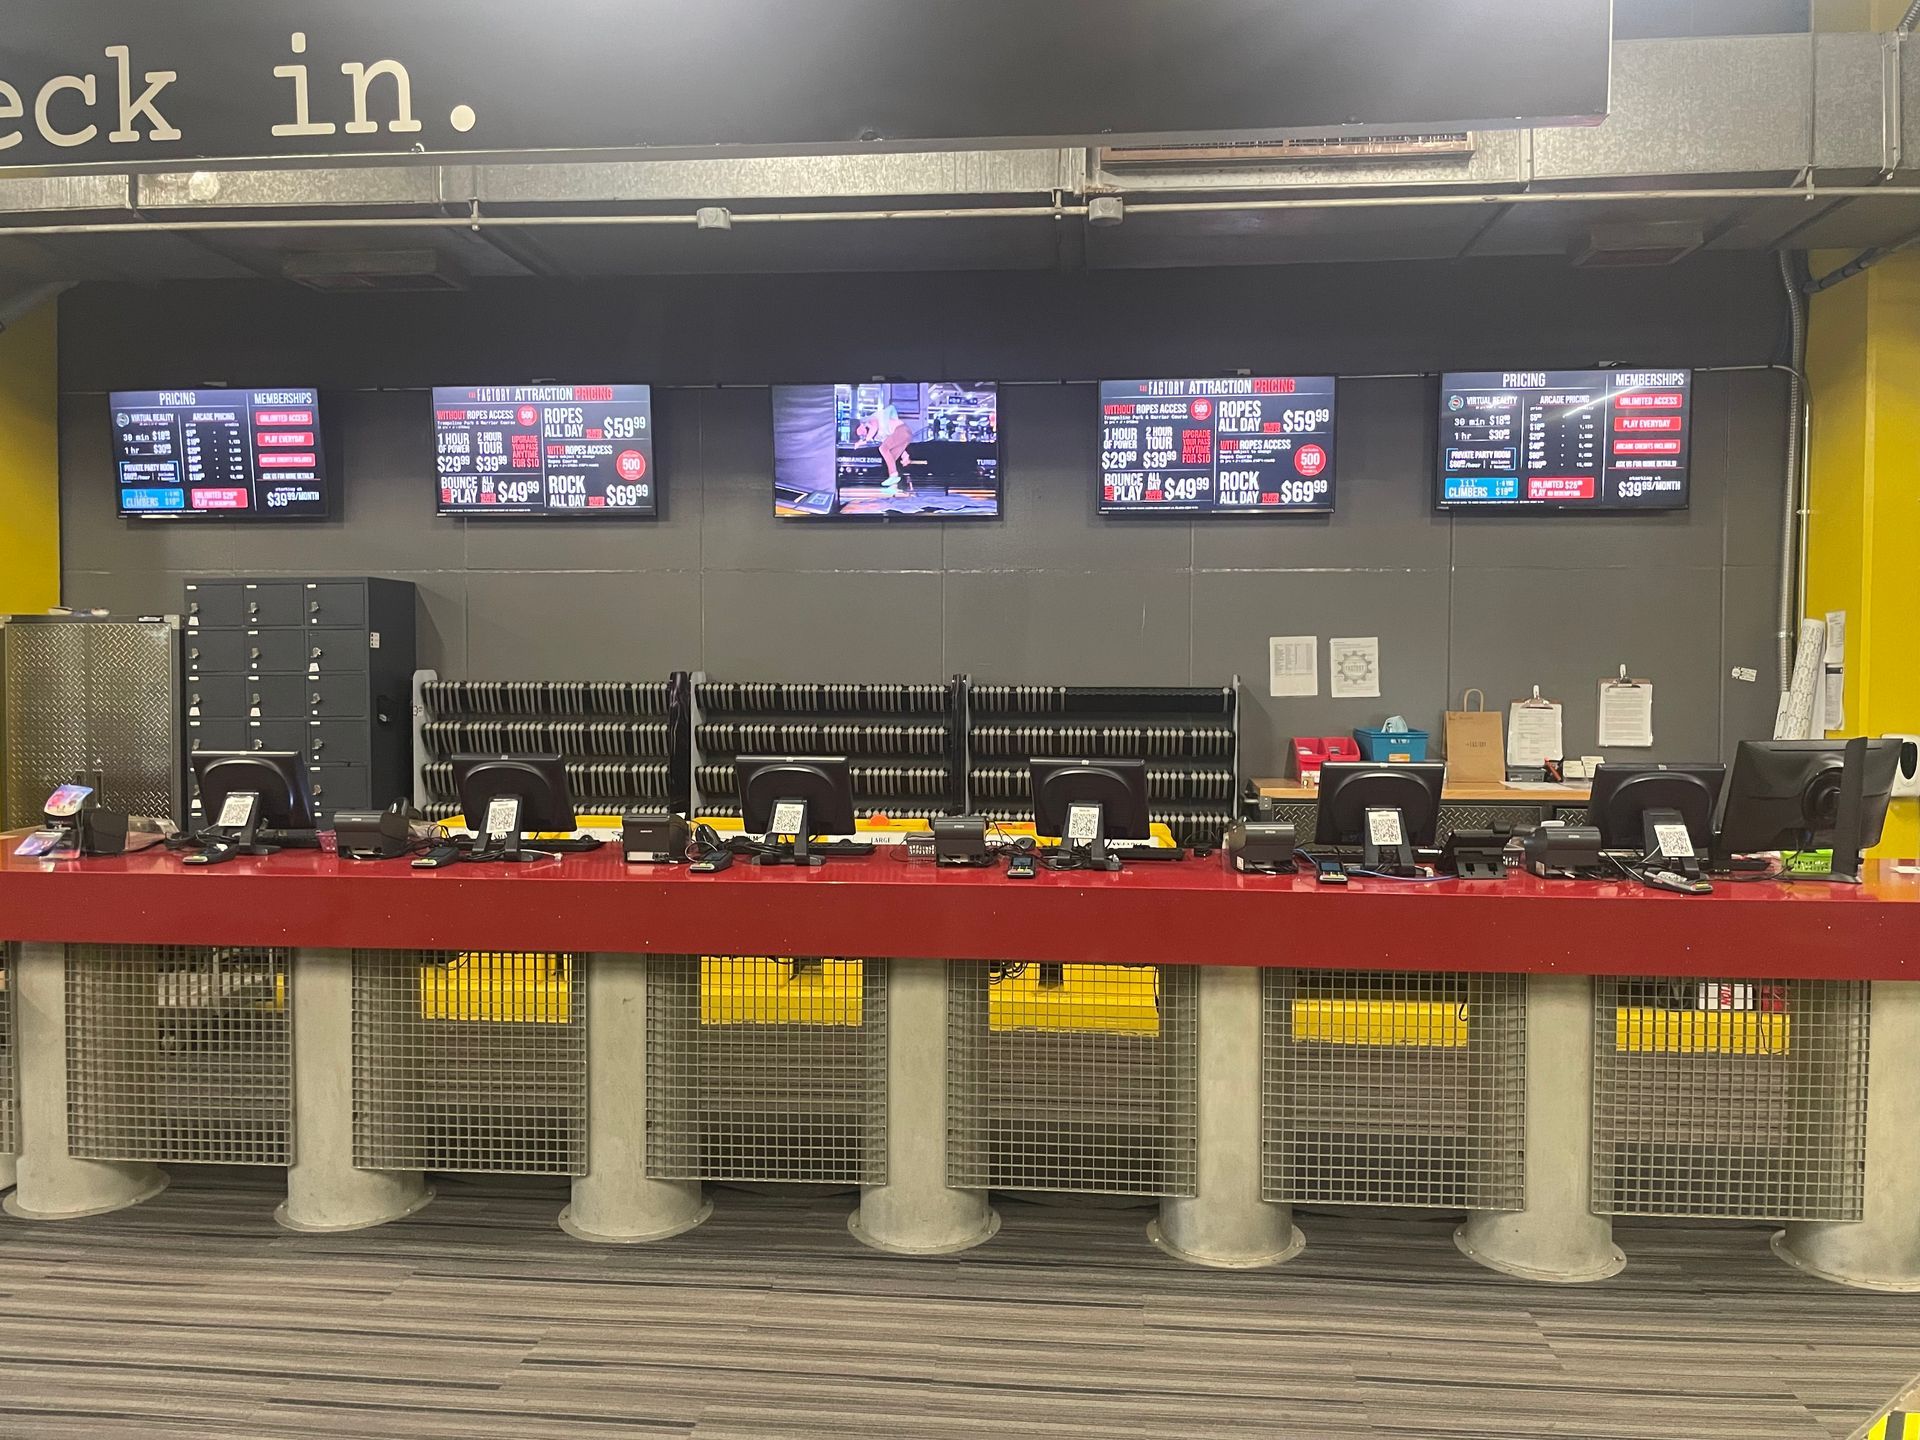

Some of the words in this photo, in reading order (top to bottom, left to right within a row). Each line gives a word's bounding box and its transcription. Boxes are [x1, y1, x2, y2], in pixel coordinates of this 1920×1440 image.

[271, 32, 476, 137] in.
[1503, 373, 1546, 387] PRICING
[1616, 373, 1684, 386] MEMBERSHIPS
[1149, 381, 1184, 395] FACTORY
[1188, 380, 1251, 394] ATTRACTION
[1253, 379, 1296, 393] PRICING
[160, 392, 196, 405] PRICING
[254, 392, 312, 404] MEMBERSHIPS
[477, 388, 510, 401] FACTORY
[515, 388, 572, 401] ATTRACTION
[575, 387, 613, 400] PRICING
[1540, 396, 1564, 404] ARCADE
[1566, 395, 1589, 403] PRICING
[1466, 396, 1490, 405] VIRTUAL
[1493, 396, 1518, 404] REALITY
[1620, 398, 1653, 406] UNLIMITED
[1654, 397, 1677, 405] ACCESS
[1104, 405, 1135, 414] WITHOUT
[1136, 404, 1158, 414] ROPES
[1160, 404, 1186, 414] ACCESS
[1219, 400, 1261, 418] ROPES
[437, 410, 465, 420] WITHOUT
[467, 410, 488, 419] ROPES
[488, 410, 514, 419] ACCESS
[544, 407, 583, 424] ROPES
[1218, 418, 1238, 432] ALL
[1240, 418, 1261, 432] DAY
[1454, 418, 1465, 426] 30
[1623, 420, 1638, 428] PLAY
[1640, 419, 1671, 427] EVERYDAY
[545, 424, 562, 437] ALL
[565, 424, 583, 437] DAY
[1104, 428, 1109, 440] 1
[1112, 428, 1137, 440] HOUR
[1146, 427, 1152, 437] 2
[1153, 427, 1172, 436] HOUR
[1183, 430, 1211, 438] UPGRADE
[1454, 432, 1459, 440] 1
[1462, 432, 1472, 440] hr
[438, 433, 443, 445] 1
[445, 433, 469, 445] HOUR
[477, 432, 482, 441] 2
[483, 432, 502, 441] HOUR
[478, 442, 502, 454] TOUR
[1104, 440, 1112, 449] OF
[1113, 440, 1137, 449] POWER
[1146, 437, 1172, 449] TOUR
[1220, 440, 1239, 450] WITH
[1240, 440, 1263, 449] ROPES
[1264, 439, 1291, 449] ACCESS
[131, 446, 139, 454] hr
[438, 445, 447, 453] OF
[448, 445, 470, 453] POWER
[547, 445, 565, 454] WITH
[565, 445, 586, 454] ROPES
[587, 445, 613, 454] ACCESS
[1183, 446, 1210, 454] ANYTIME
[1451, 450, 1474, 459] PRIVATE
[1475, 450, 1494, 459] PARTY
[513, 459, 526, 467] FOR
[527, 459, 539, 467] $10
[1182, 454, 1196, 463] FOR
[1197, 454, 1210, 463] $10
[1301, 453, 1320, 465] 500
[622, 459, 640, 470] 500
[441, 476, 477, 488] BOUNCE
[1104, 473, 1143, 486] BOUNCE
[1148, 472, 1159, 481] ALL
[1220, 471, 1259, 490] ROCK
[548, 475, 586, 494] ROCK
[1148, 480, 1161, 490] DAY
[1531, 480, 1563, 488] UNLIMITED
[451, 488, 477, 503] PLAY
[1114, 486, 1143, 500] PLAY
[1220, 491, 1238, 504] ALL
[1240, 491, 1259, 504] DAY
[1448, 487, 1488, 497] CLIMBERS
[550, 495, 567, 506] ALL
[568, 495, 586, 506] DAY
